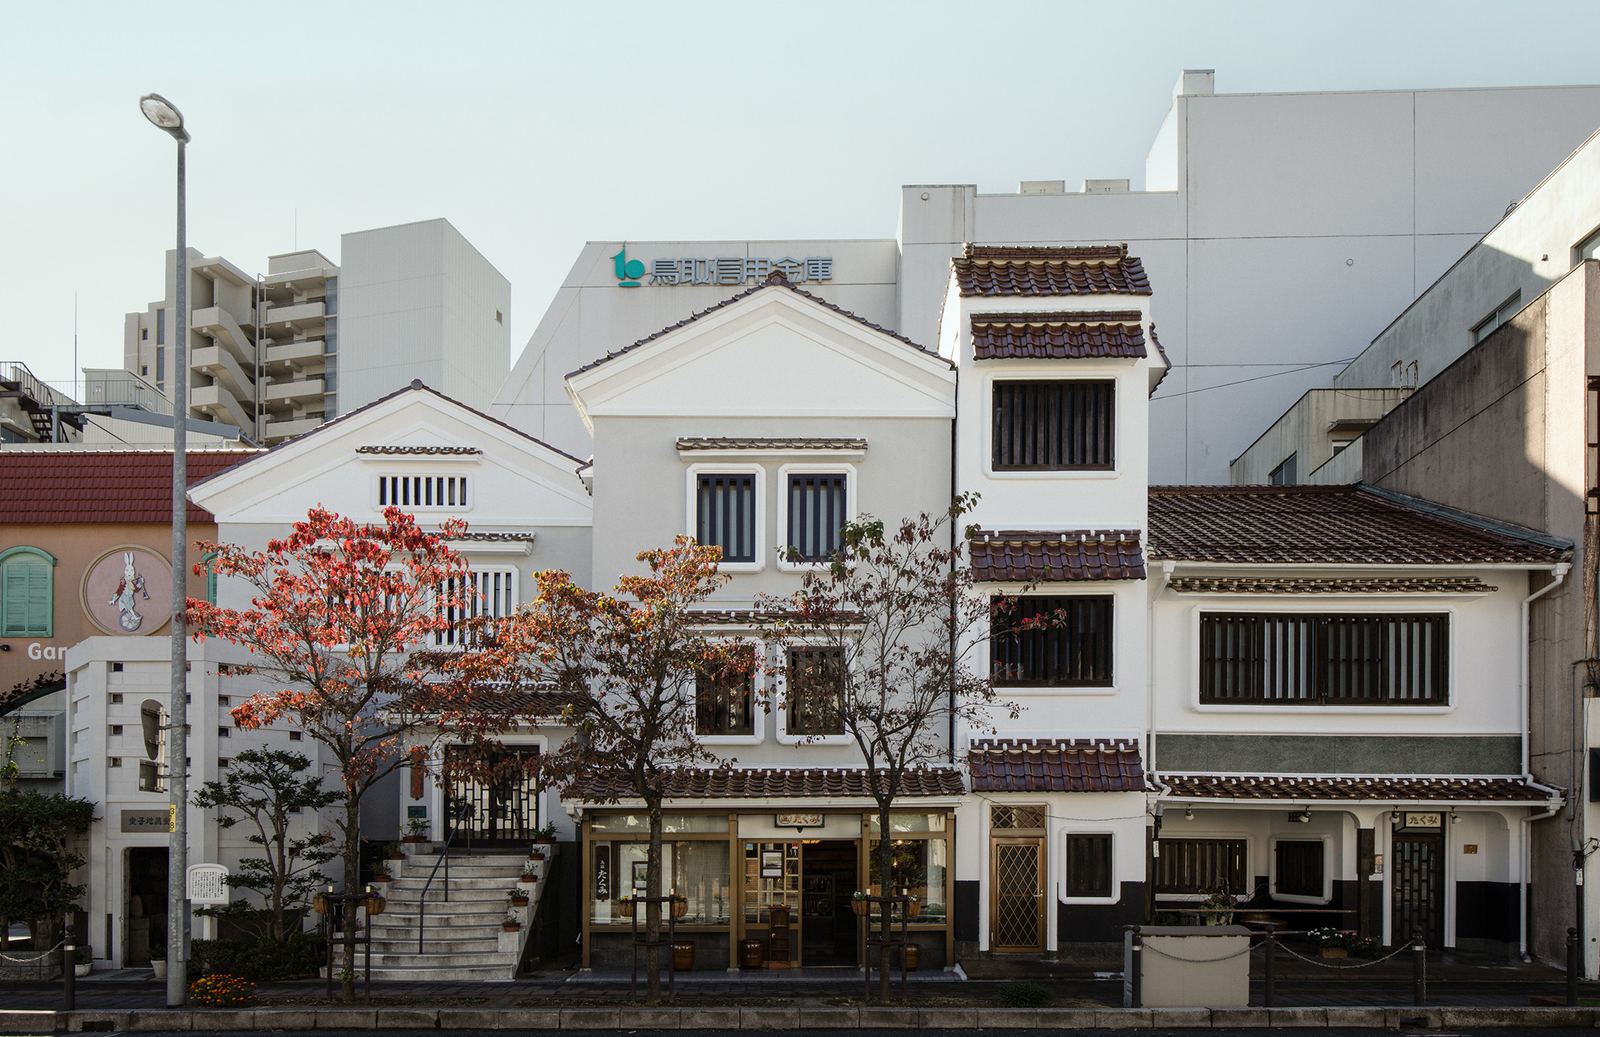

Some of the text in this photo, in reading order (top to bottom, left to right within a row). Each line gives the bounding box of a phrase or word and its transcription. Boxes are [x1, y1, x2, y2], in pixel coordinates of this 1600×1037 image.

[649, 256, 832, 285] 鳥取信用金庫
[1408, 815, 1438, 825] たくみ
